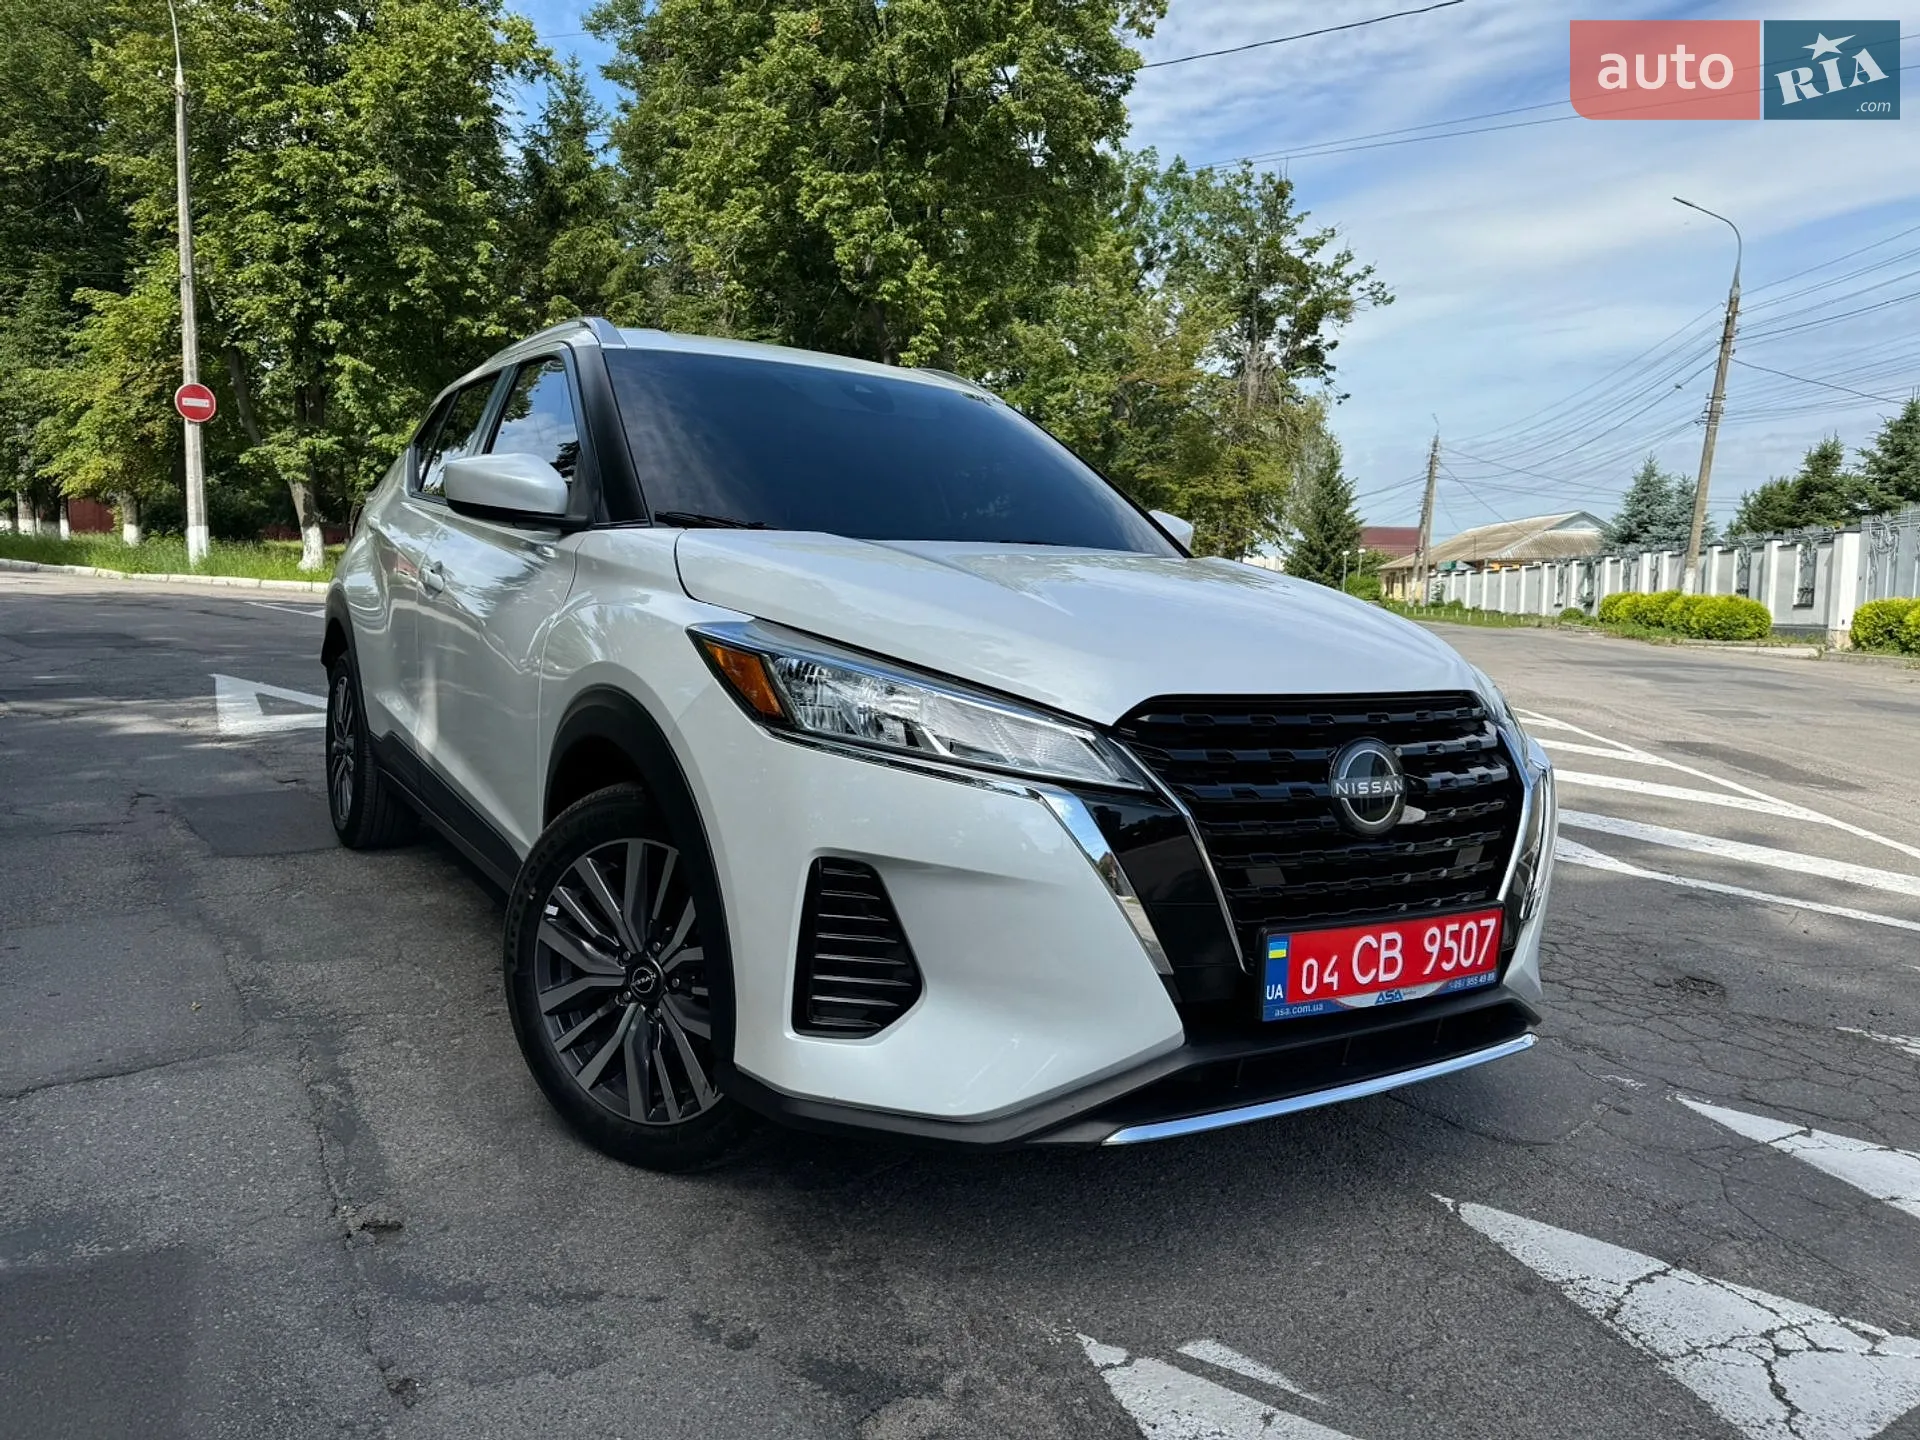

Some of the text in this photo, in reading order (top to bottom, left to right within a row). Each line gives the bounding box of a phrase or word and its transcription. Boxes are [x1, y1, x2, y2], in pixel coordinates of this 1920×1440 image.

[1335, 780, 1403, 795] NISSAN
[1301, 918, 1496, 995] 04 CB 9507
[1266, 983, 1283, 1000] UA
[1374, 989, 1403, 1004] ASA
[1274, 1003, 1324, 1017] asa.com.ua
